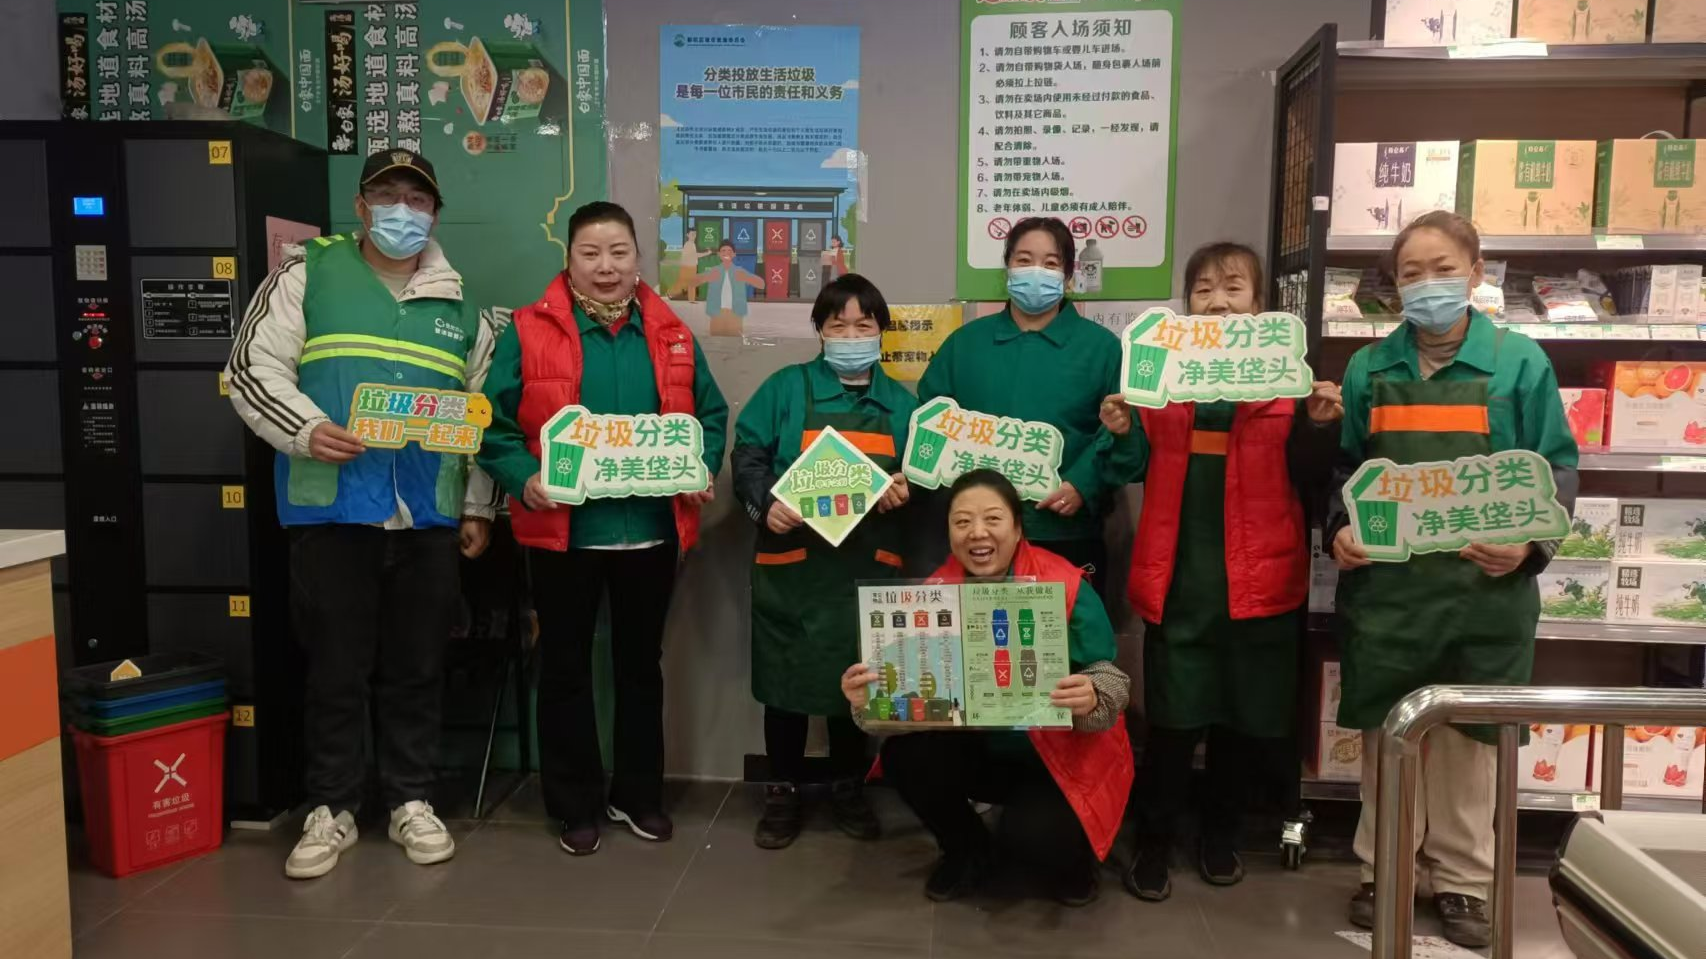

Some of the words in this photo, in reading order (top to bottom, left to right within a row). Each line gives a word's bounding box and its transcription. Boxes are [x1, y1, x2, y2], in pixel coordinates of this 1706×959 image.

[1009, 19, 1132, 39] 顾客入场须知
[703, 67, 816, 82] 分类投放生活垃圾
[675, 84, 843, 100] 是每一位市民的责任和义务
[211, 146, 228, 159] 07
[1378, 161, 1412, 184] 纯牛奶
[216, 262, 233, 275] 08
[1152, 317, 1292, 351] 垃圾分类
[1177, 356, 1297, 386] 净美垡头
[358, 388, 467, 421] 垃圾分类
[353, 416, 478, 449] 我们一起来
[570, 416, 691, 450] 垃圾分类
[936, 409, 1053, 456] 垃圾分类
[594, 455, 696, 482] 净美垡头
[790, 459, 873, 493] 垃圾分类
[1376, 457, 1536, 503] 垃圾分类
[225, 491, 242, 504] 10
[1412, 498, 1552, 537] 净美垡头
[1618, 531, 1642, 554] 纯牛奶
[232, 601, 246, 612] 11
[885, 589, 943, 604] 垃圾分类
[1615, 594, 1640, 617] 纯牛奶
[236, 709, 250, 721] 12
